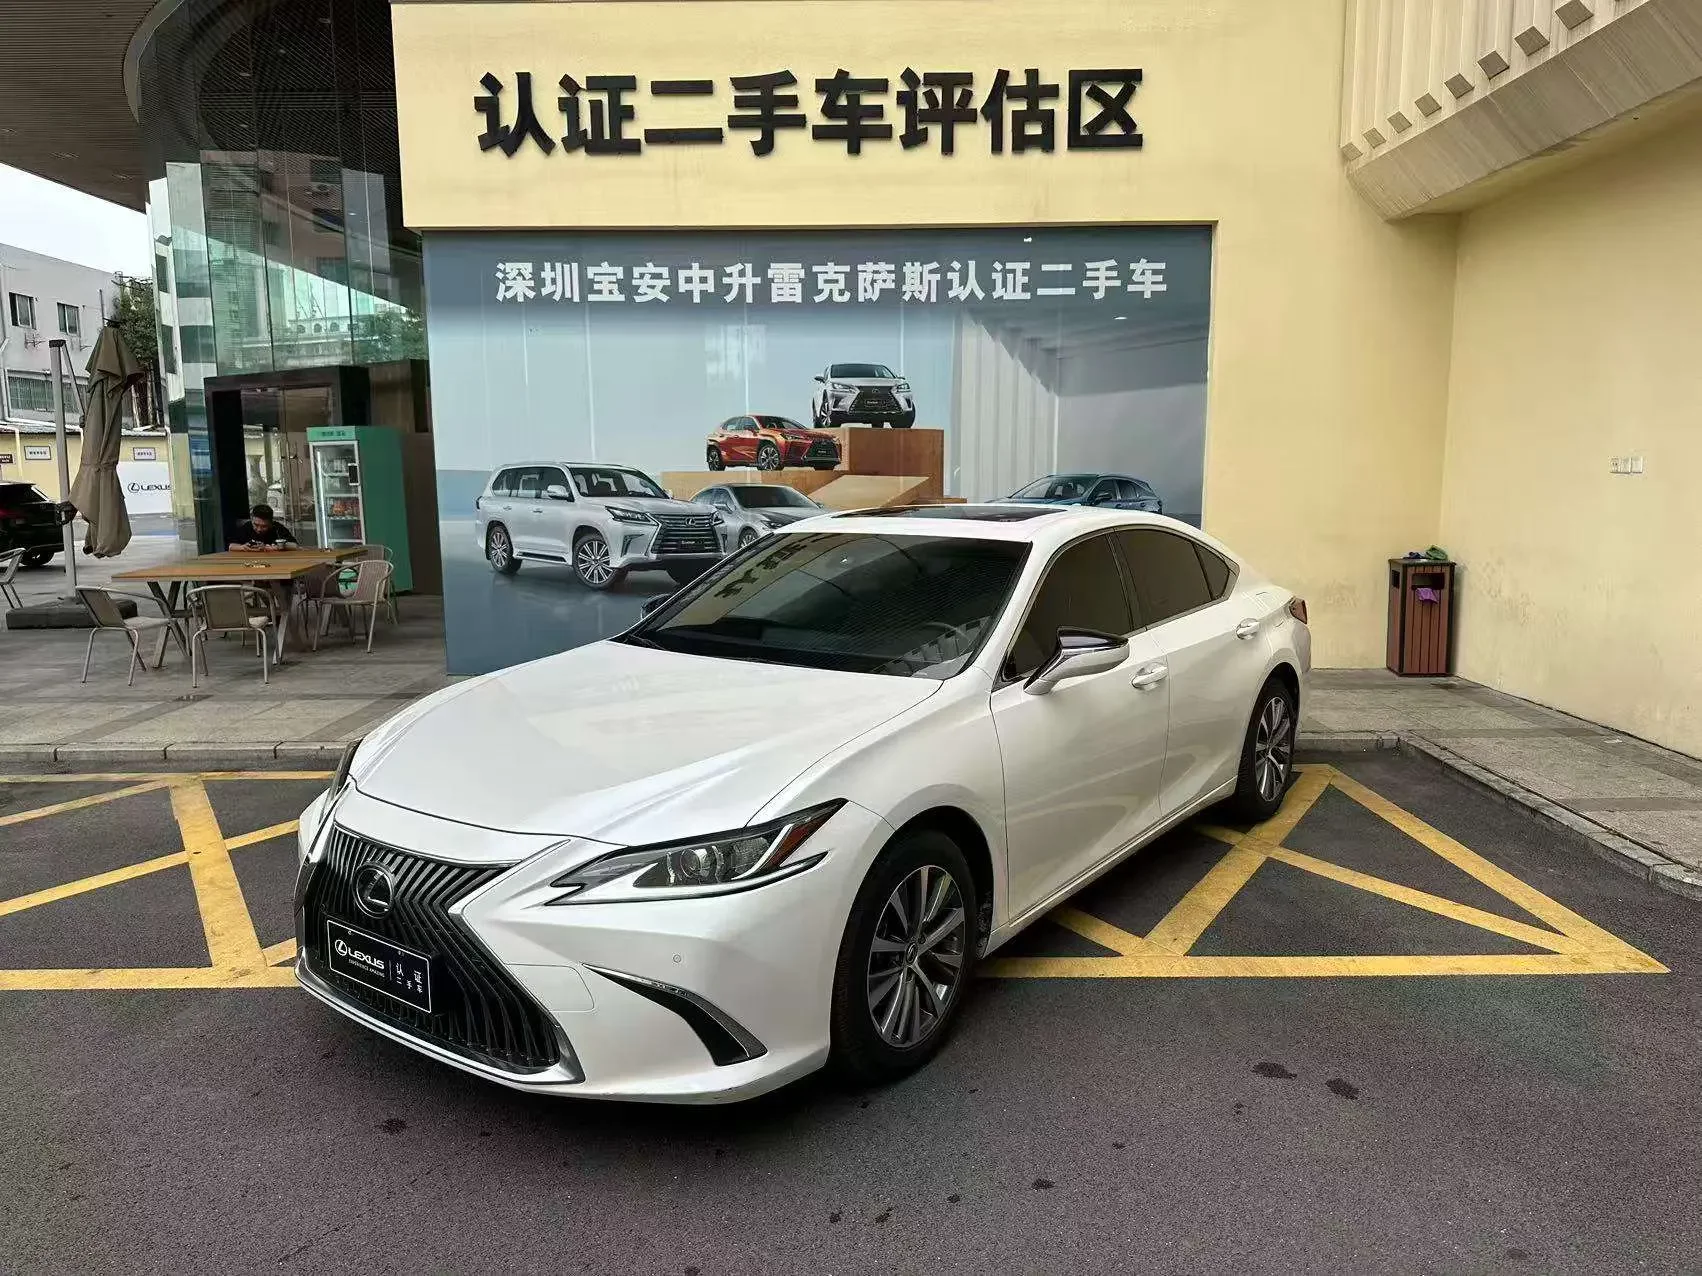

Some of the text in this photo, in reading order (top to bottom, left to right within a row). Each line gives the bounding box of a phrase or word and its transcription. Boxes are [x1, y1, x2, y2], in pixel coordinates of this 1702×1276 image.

[474, 67, 1143, 157] 认证二手车评估区
[495, 258, 1168, 304] 深圳宝安中升雷克萨斯认证二手车
[347, 946, 385, 970] LEXUS
